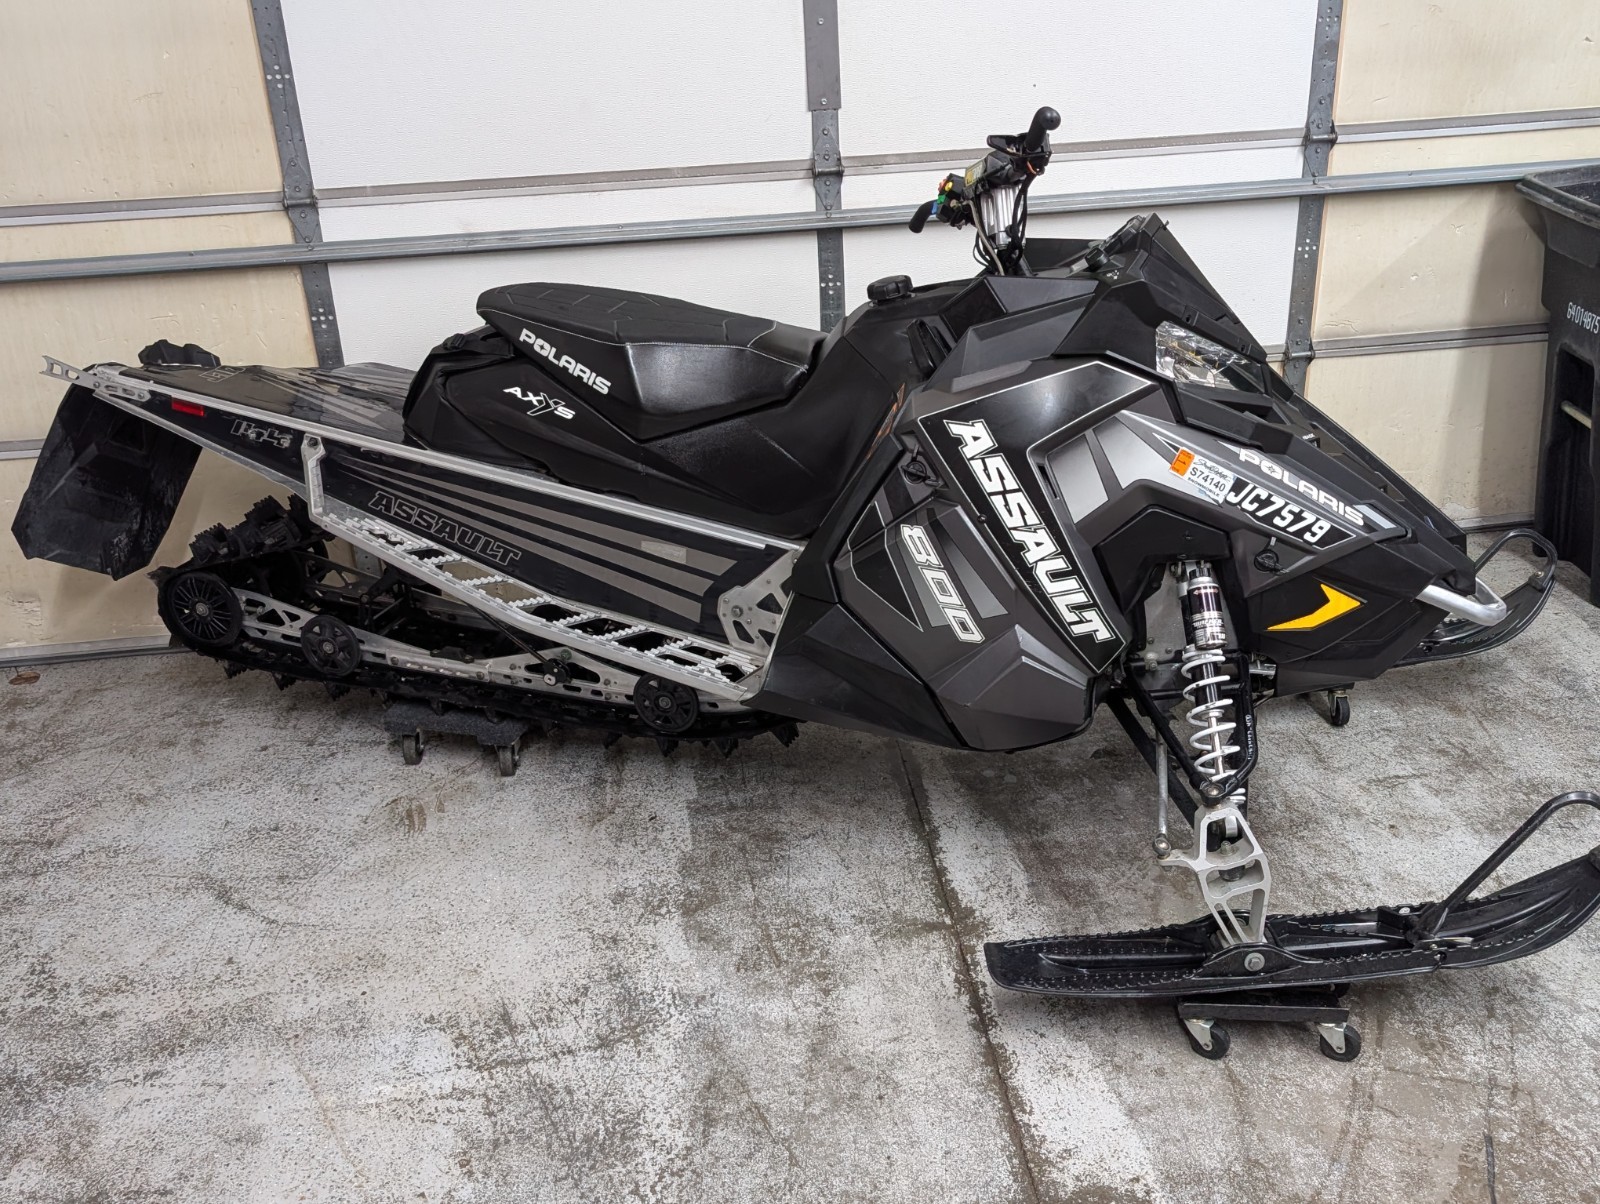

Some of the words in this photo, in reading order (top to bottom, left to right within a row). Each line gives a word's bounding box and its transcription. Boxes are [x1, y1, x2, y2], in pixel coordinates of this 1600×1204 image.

[519, 327, 612, 395] POLARIS
[1190, 466, 1226, 492] S74140
[1225, 484, 1332, 544] JC7579
[1238, 448, 1365, 526] POLARIS
[368, 491, 522, 566] ASSAULT
[943, 418, 1116, 643] ASSAULT
[900, 523, 986, 644] 800
